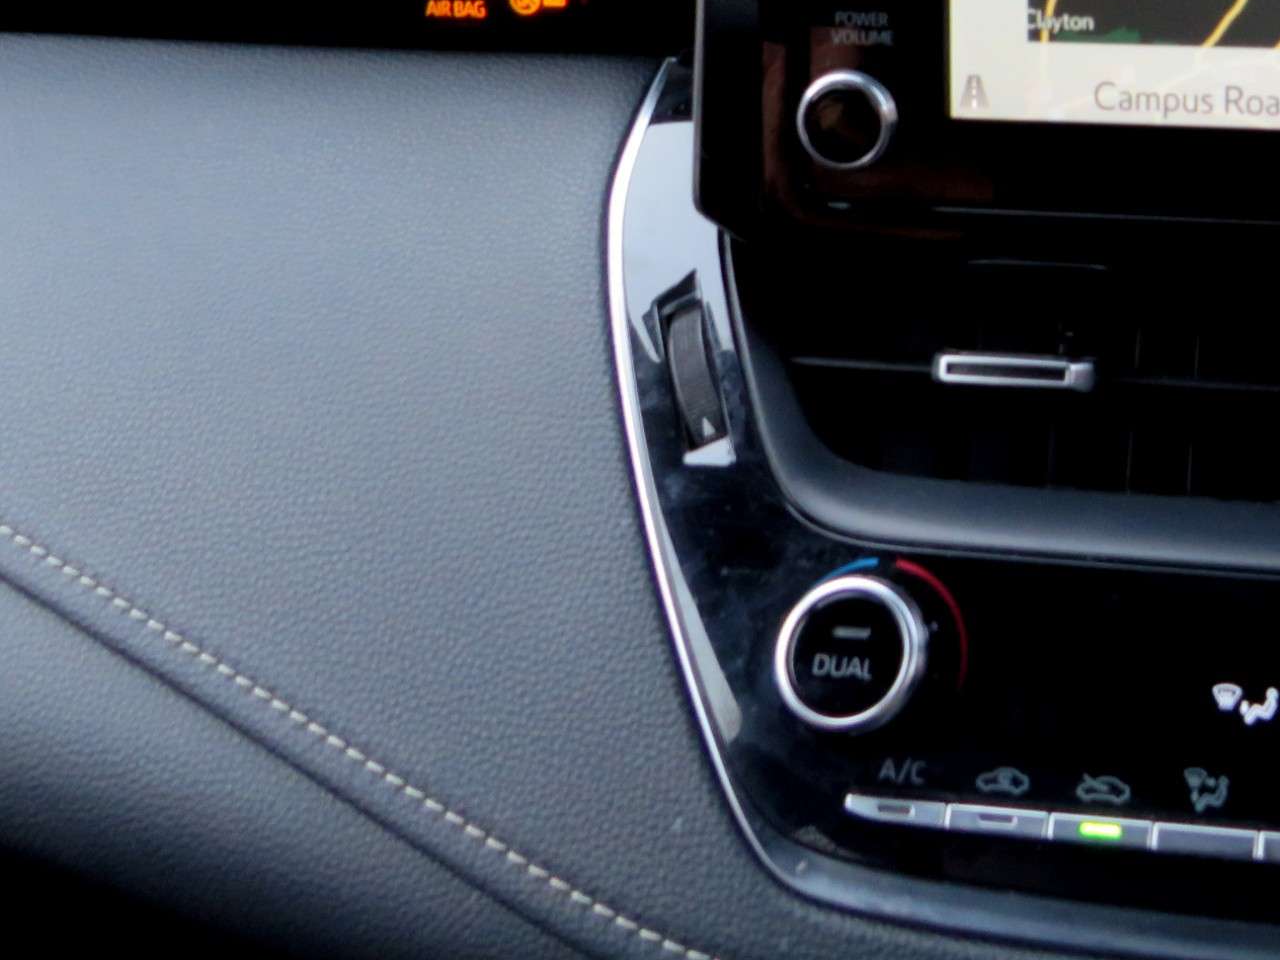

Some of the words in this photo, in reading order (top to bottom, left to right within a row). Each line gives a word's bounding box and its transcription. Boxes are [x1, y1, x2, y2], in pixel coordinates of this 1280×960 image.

[425, 0, 452, 17] AIR
[453, 0, 487, 19] BAG
[835, 10, 890, 27] POWER
[831, 28, 894, 46] VOLUME
[1094, 81, 1214, 115] Campus
[811, 652, 873, 681] DUAL
[878, 757, 927, 785] A/C
